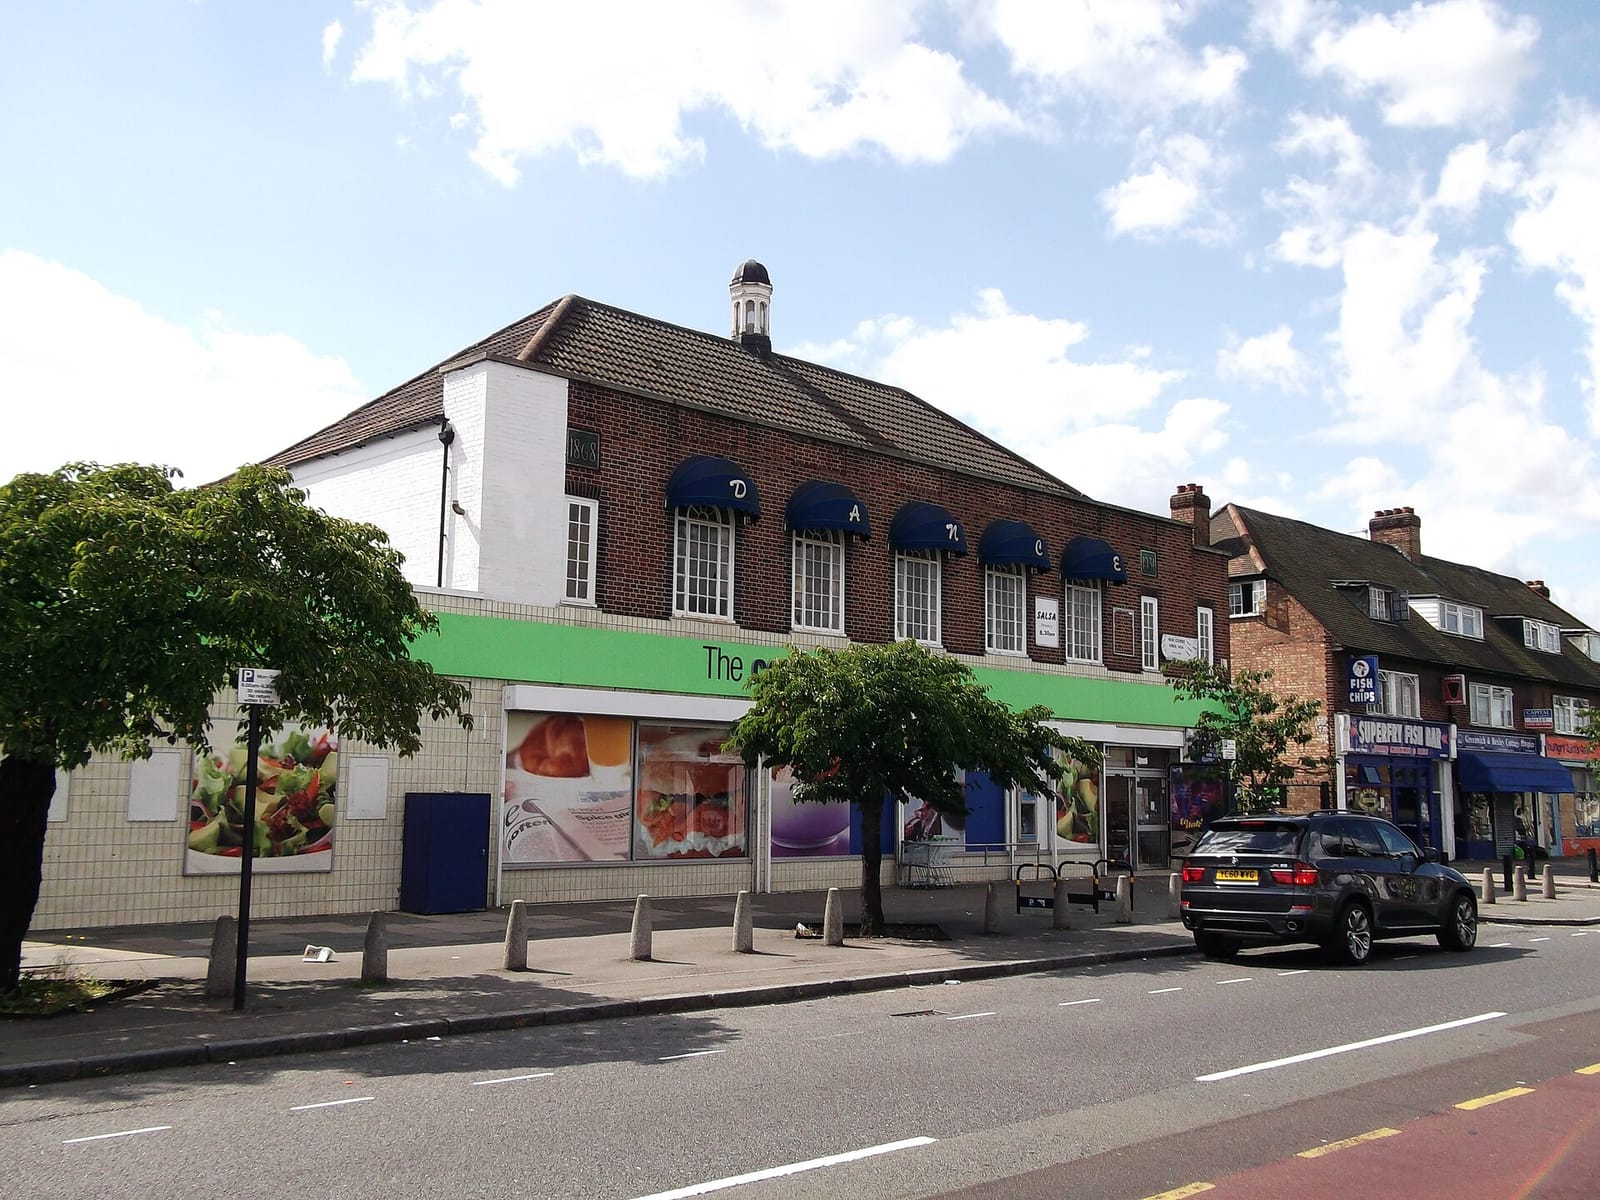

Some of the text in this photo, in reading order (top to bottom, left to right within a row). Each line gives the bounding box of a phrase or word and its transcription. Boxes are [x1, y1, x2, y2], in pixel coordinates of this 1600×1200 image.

[570, 437, 597, 463] 1868
[729, 480, 1122, 572] D A N C E
[1036, 611, 1056, 621] SALSA
[702, 645, 744, 682] The
[243, 670, 253, 682] P
[1350, 678, 1374, 689] FISH
[1349, 691, 1376, 703] CHIPS
[1358, 719, 1403, 744] SUPERFRY
[1403, 724, 1424, 746] FISH
[1424, 726, 1442, 750] BAR
